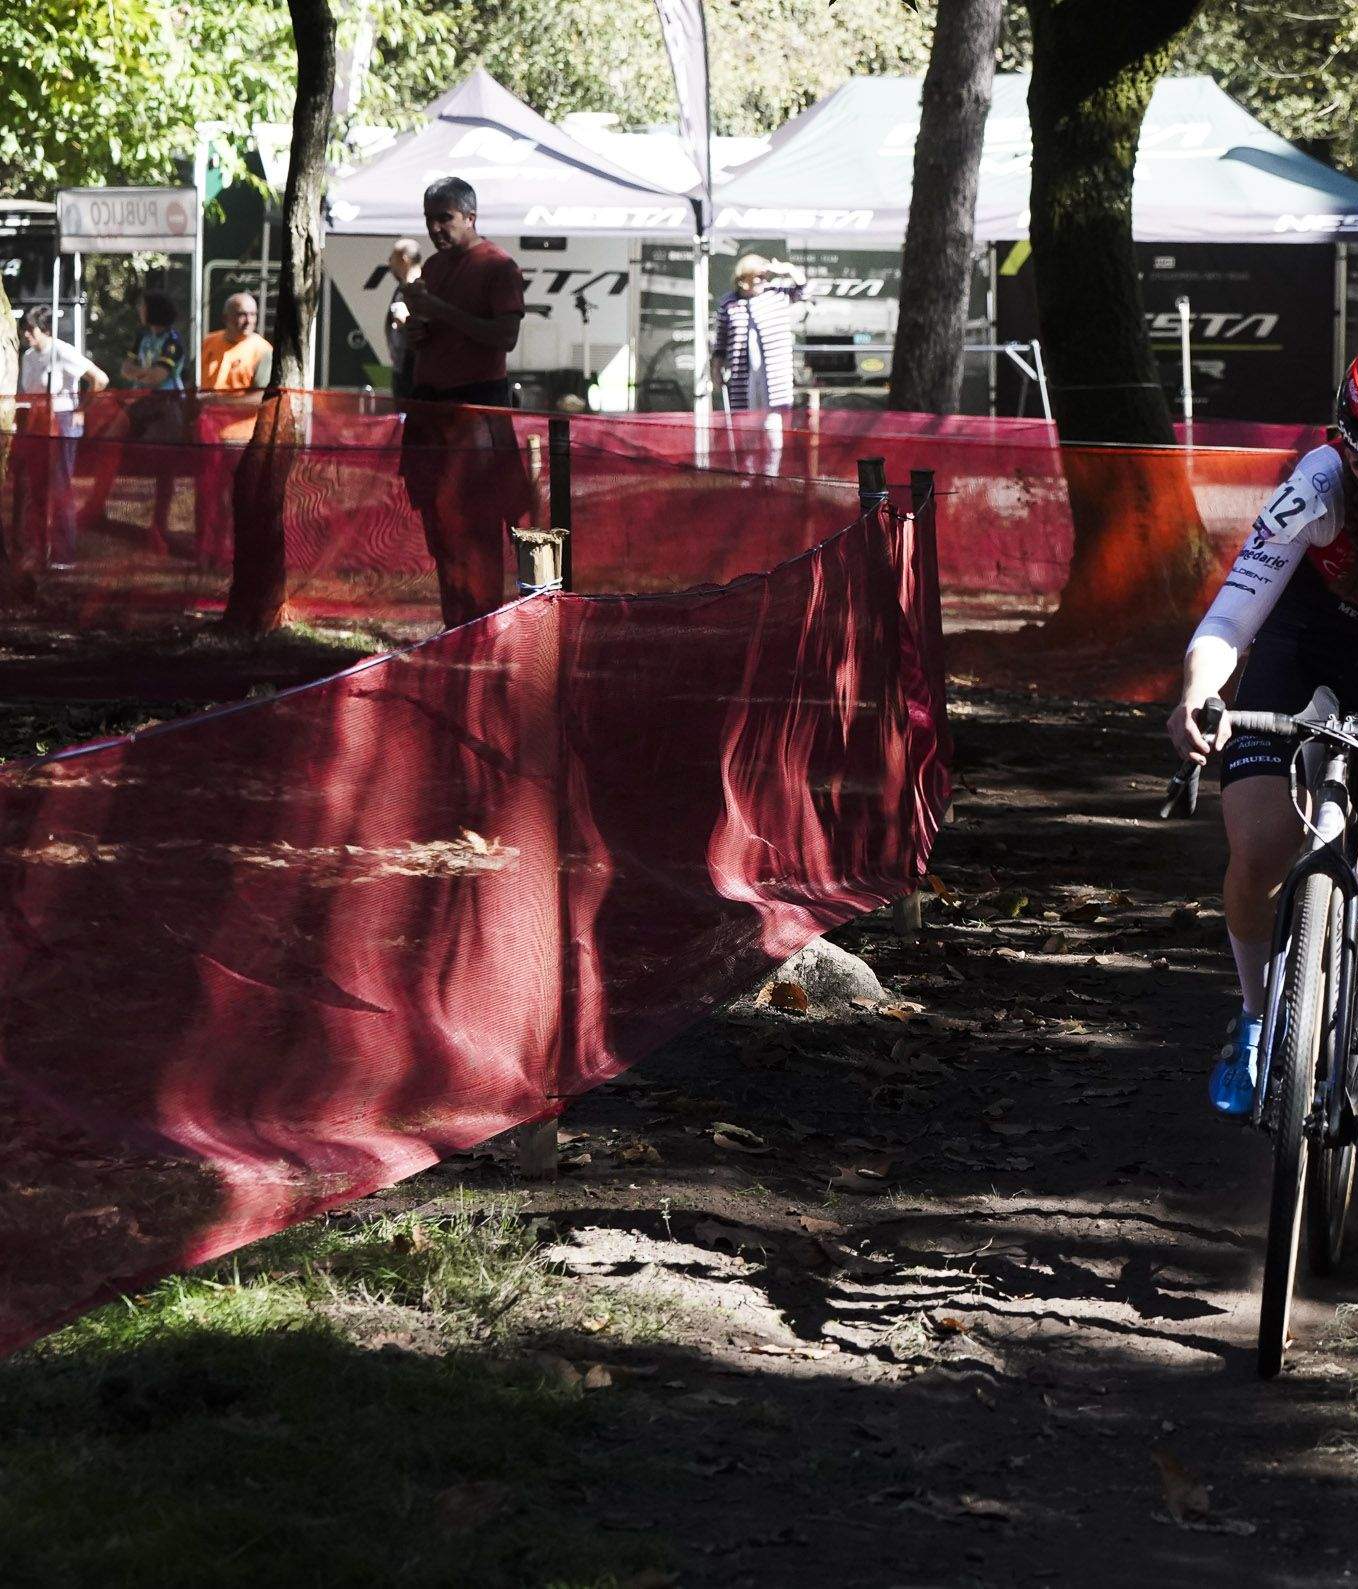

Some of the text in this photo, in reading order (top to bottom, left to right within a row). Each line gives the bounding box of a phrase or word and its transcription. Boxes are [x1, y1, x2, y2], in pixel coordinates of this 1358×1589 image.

[524, 205, 688, 227] NESTA
[714, 208, 874, 228] NESTA
[1144, 312, 1280, 338] STA
[1268, 486, 1307, 529] 12
[1229, 755, 1282, 770] MERUELO
